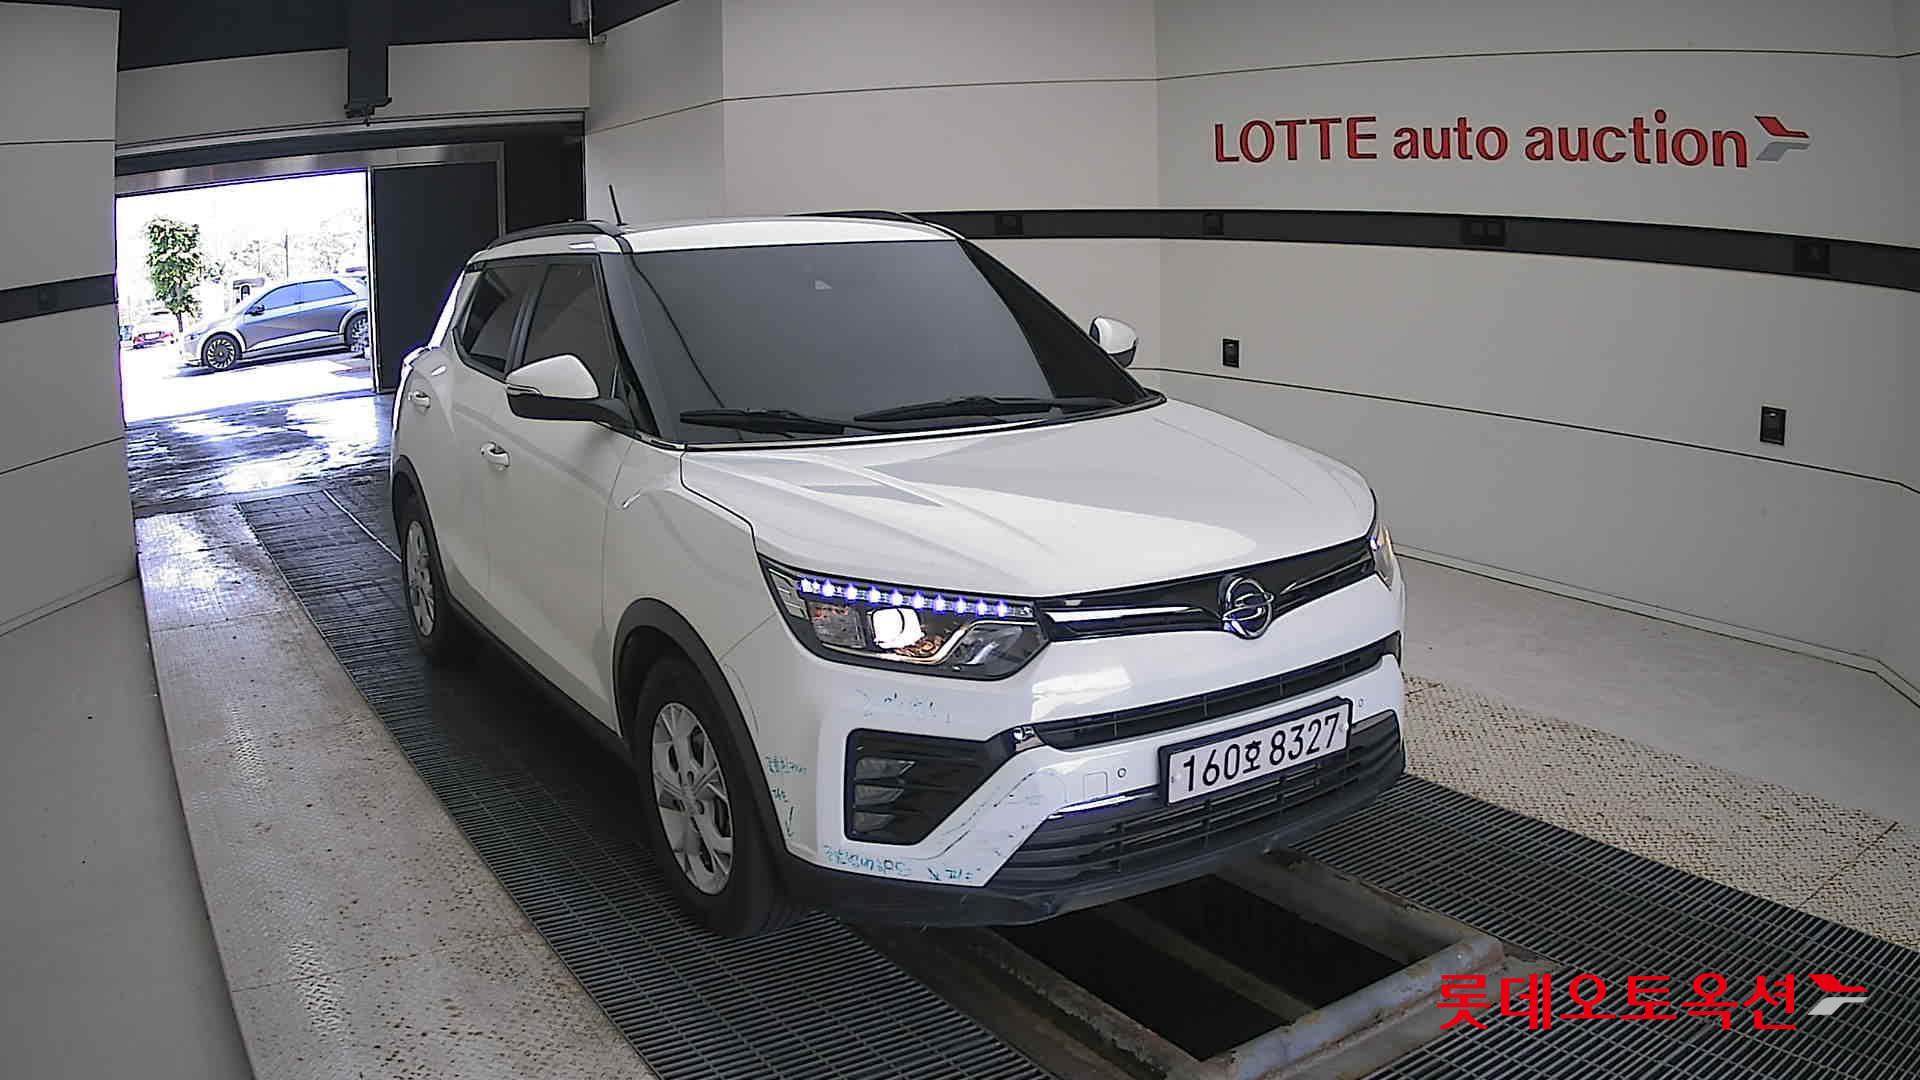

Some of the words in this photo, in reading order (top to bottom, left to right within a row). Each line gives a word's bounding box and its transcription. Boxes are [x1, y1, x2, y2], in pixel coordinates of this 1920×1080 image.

[1214, 115, 1377, 163] LOTTE
[1392, 116, 1509, 162] auto
[1524, 109, 1748, 168] auction
[1269, 712, 1340, 766] 8327
